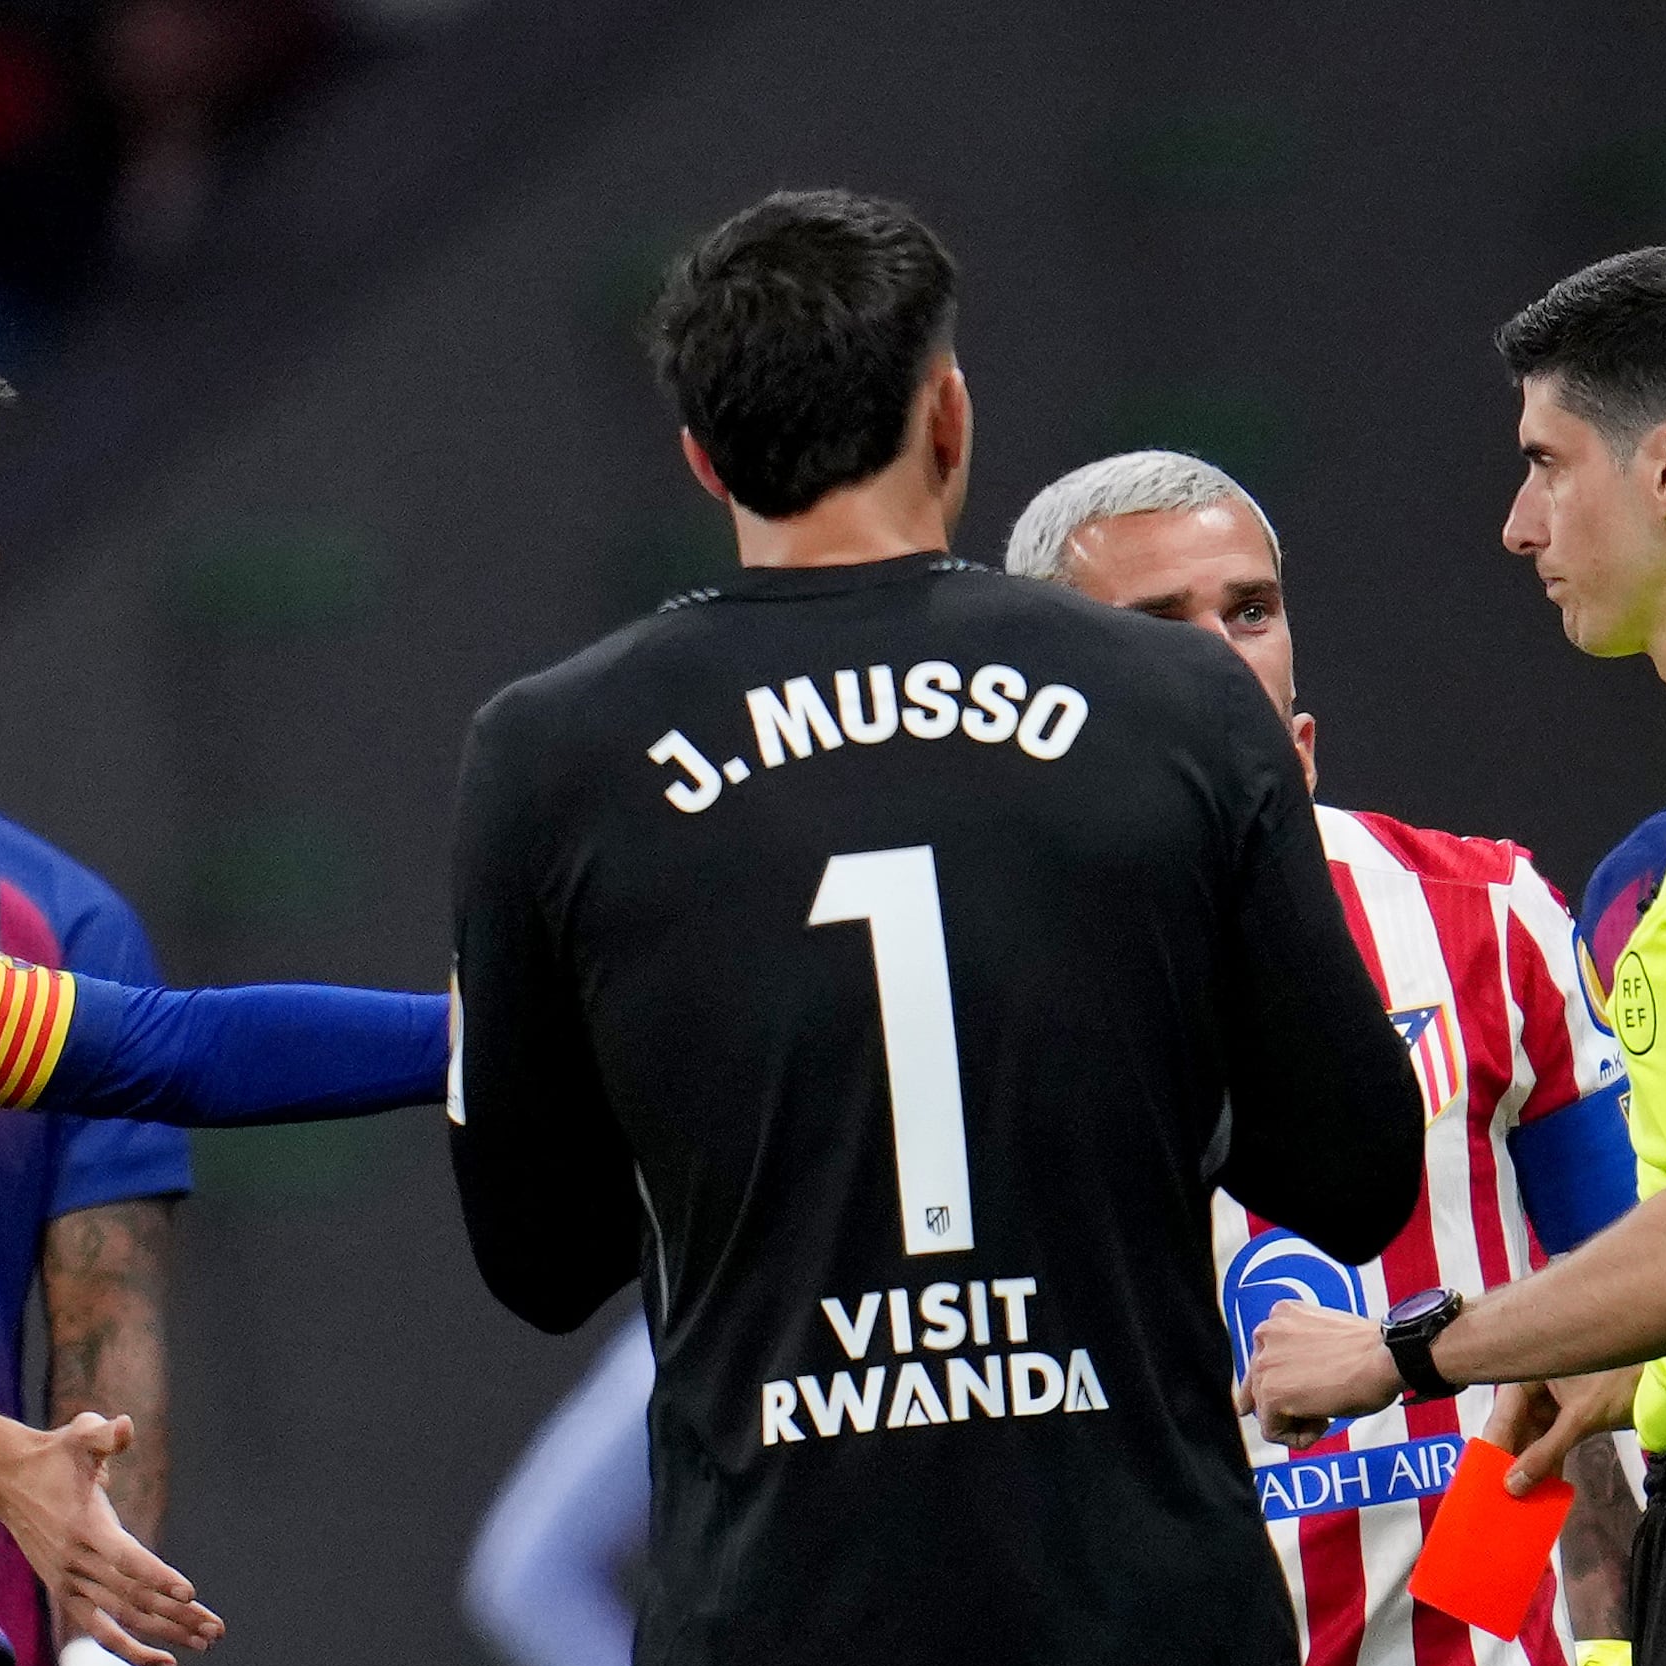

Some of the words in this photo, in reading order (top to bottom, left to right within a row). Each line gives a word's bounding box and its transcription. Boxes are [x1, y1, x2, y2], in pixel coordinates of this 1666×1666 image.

[646, 728, 751, 814] J.
[744, 659, 1090, 770] MUSSO
[1623, 978, 1642, 998] RF
[1625, 1008, 1647, 1028] EF
[806, 844, 975, 1256] 1
[821, 1277, 1037, 1360] VISIT
[762, 1348, 1109, 1446] RWANDA
[1252, 1457, 1373, 1514] ADH
[1387, 1441, 1458, 1496] AIR
